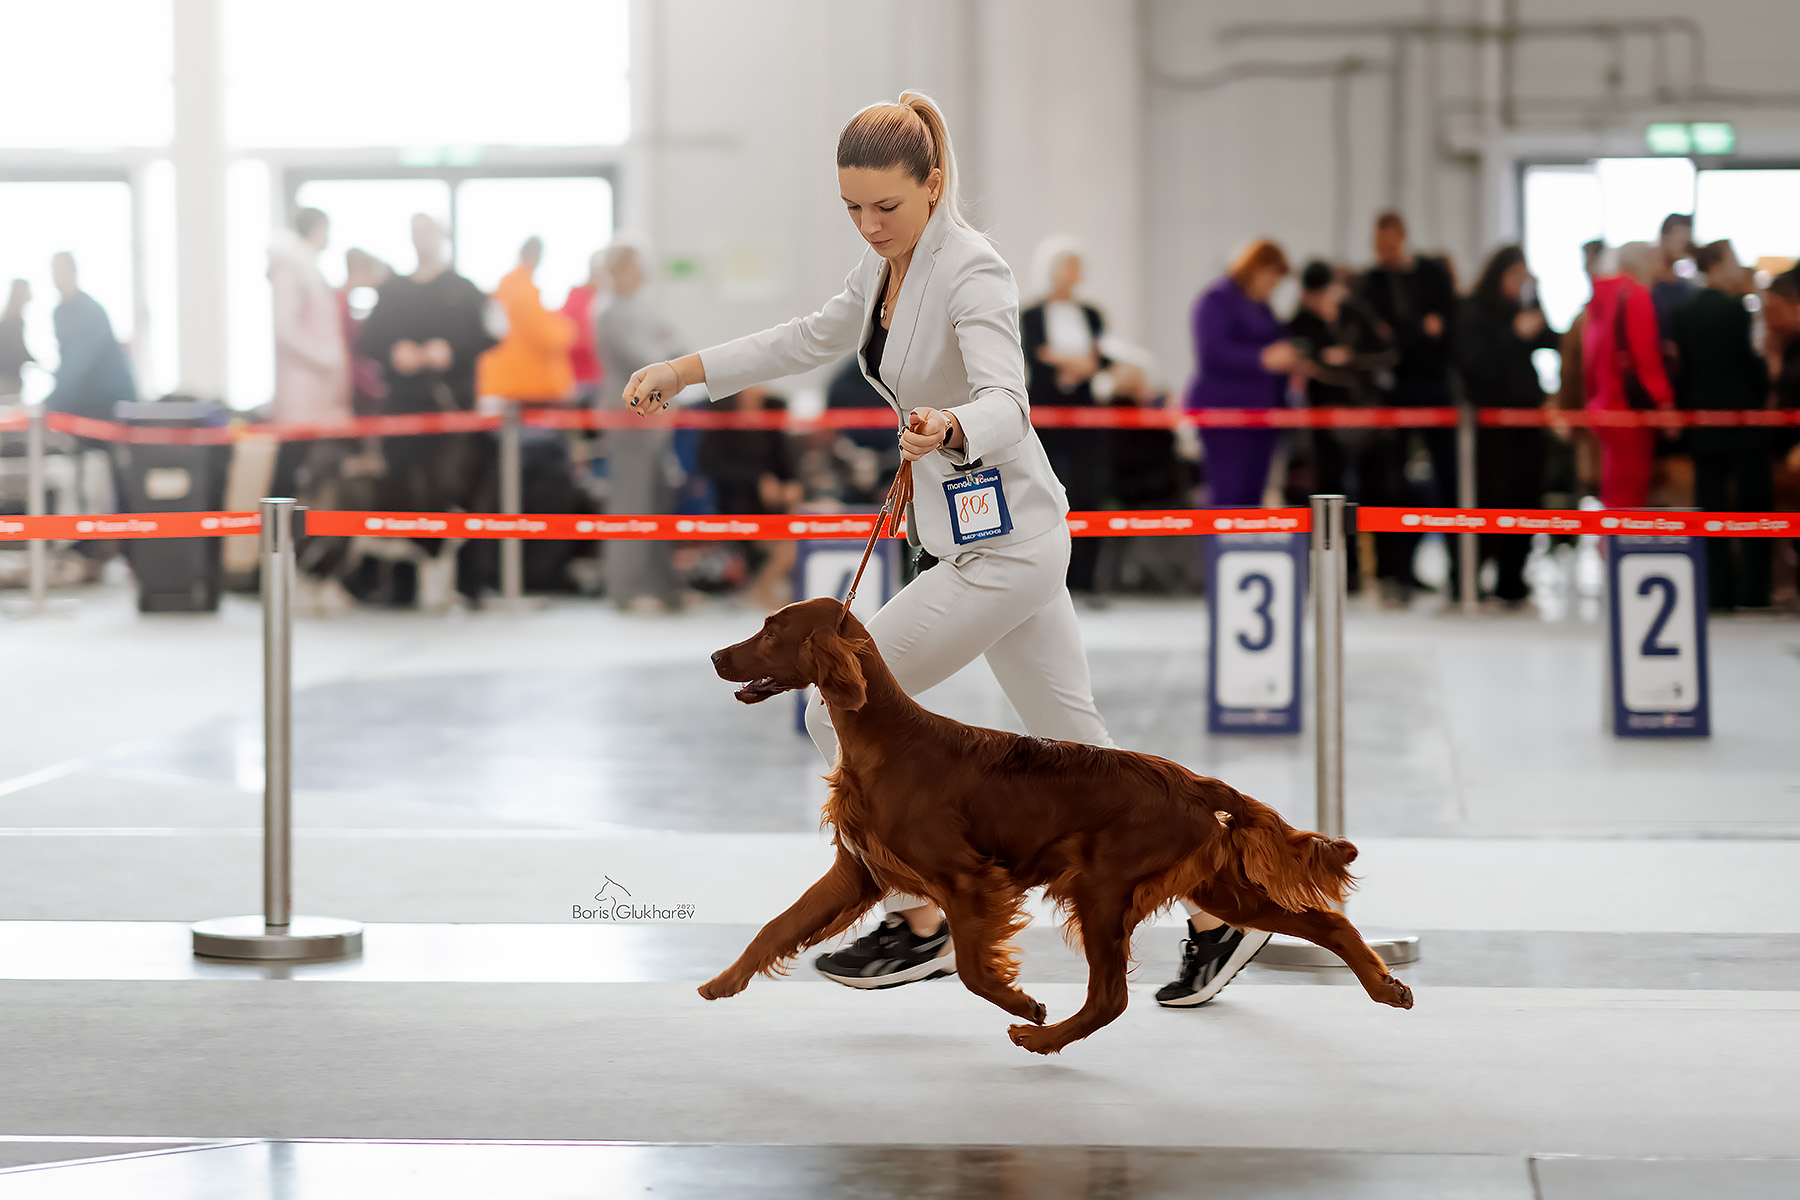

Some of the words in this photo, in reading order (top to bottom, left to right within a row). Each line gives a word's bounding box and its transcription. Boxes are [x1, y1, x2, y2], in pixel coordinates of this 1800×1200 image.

[959, 493, 989, 524] 805
[1237, 572, 1275, 652] 3
[1638, 576, 1680, 656] 2
